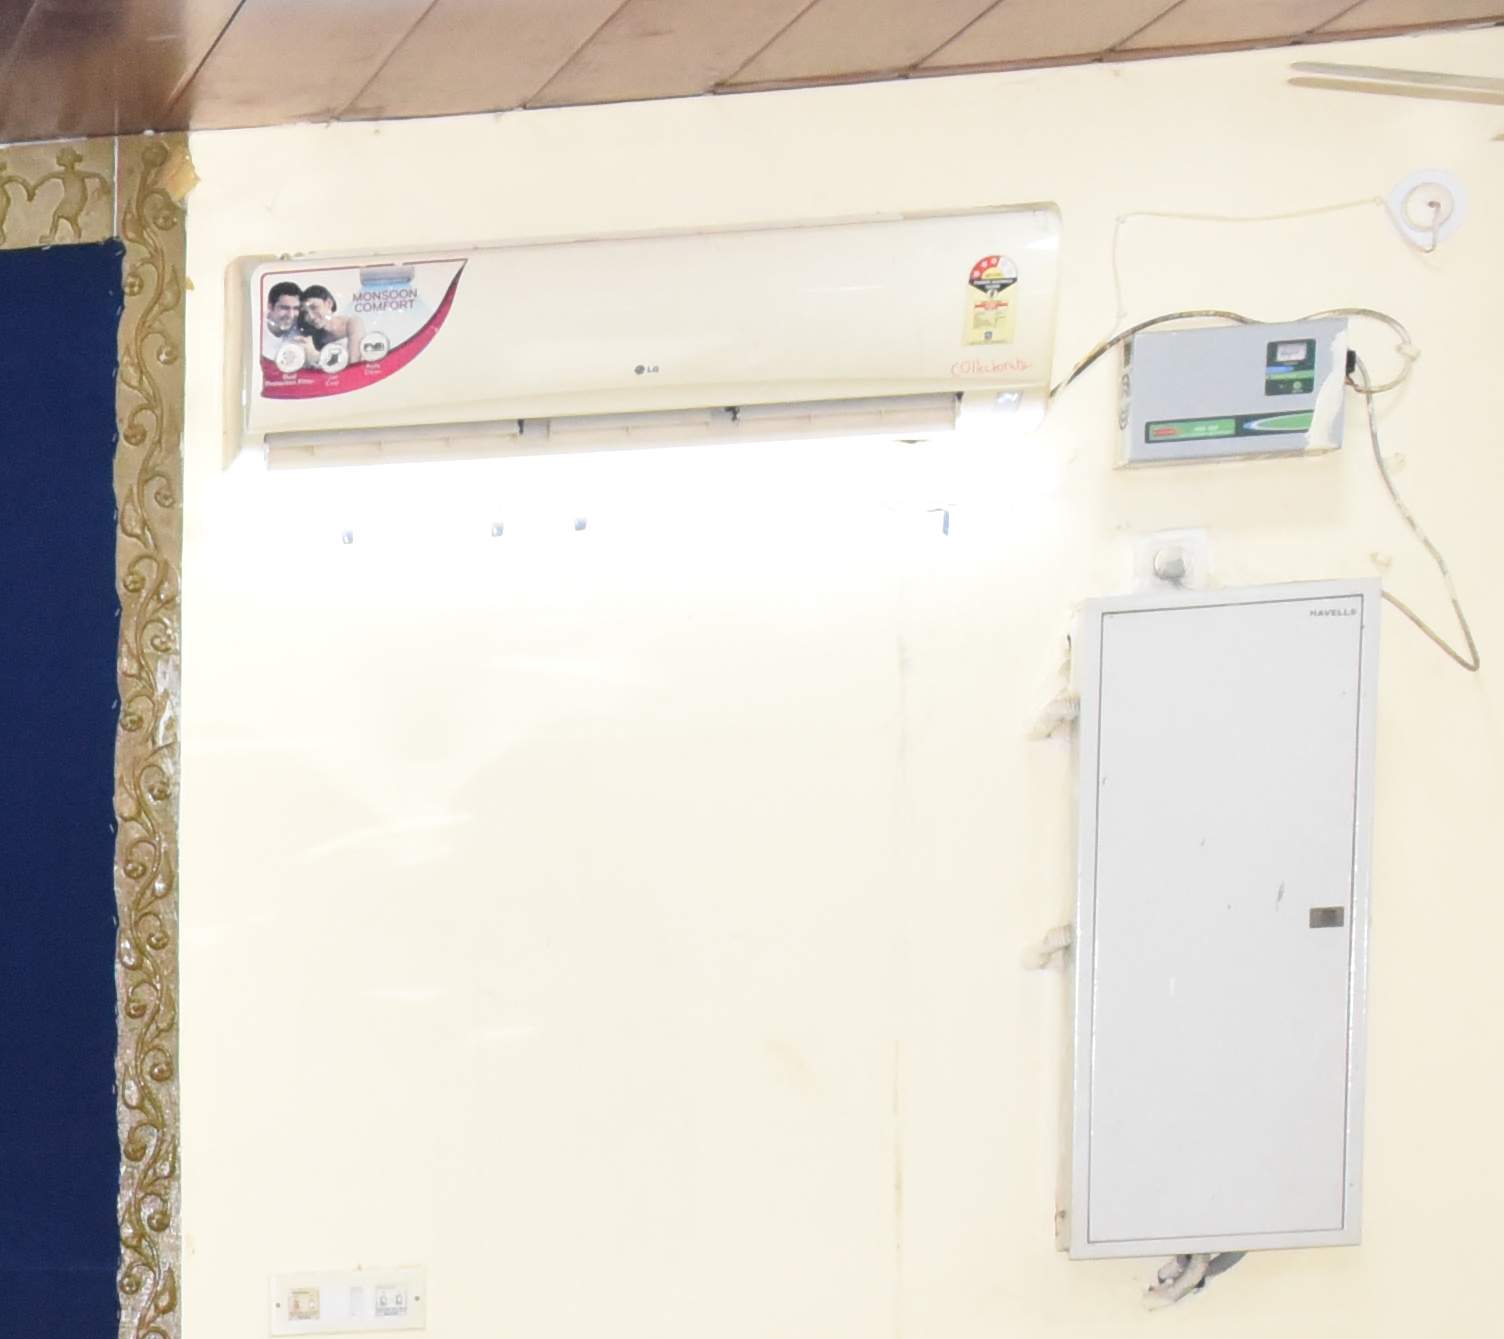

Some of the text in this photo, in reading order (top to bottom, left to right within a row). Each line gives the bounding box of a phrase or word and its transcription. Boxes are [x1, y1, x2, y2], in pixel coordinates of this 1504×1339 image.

[351, 288, 418, 303] MONSOON
[354, 299, 415, 313] COMFORT
[1309, 607, 1358, 617] HAVELLS
